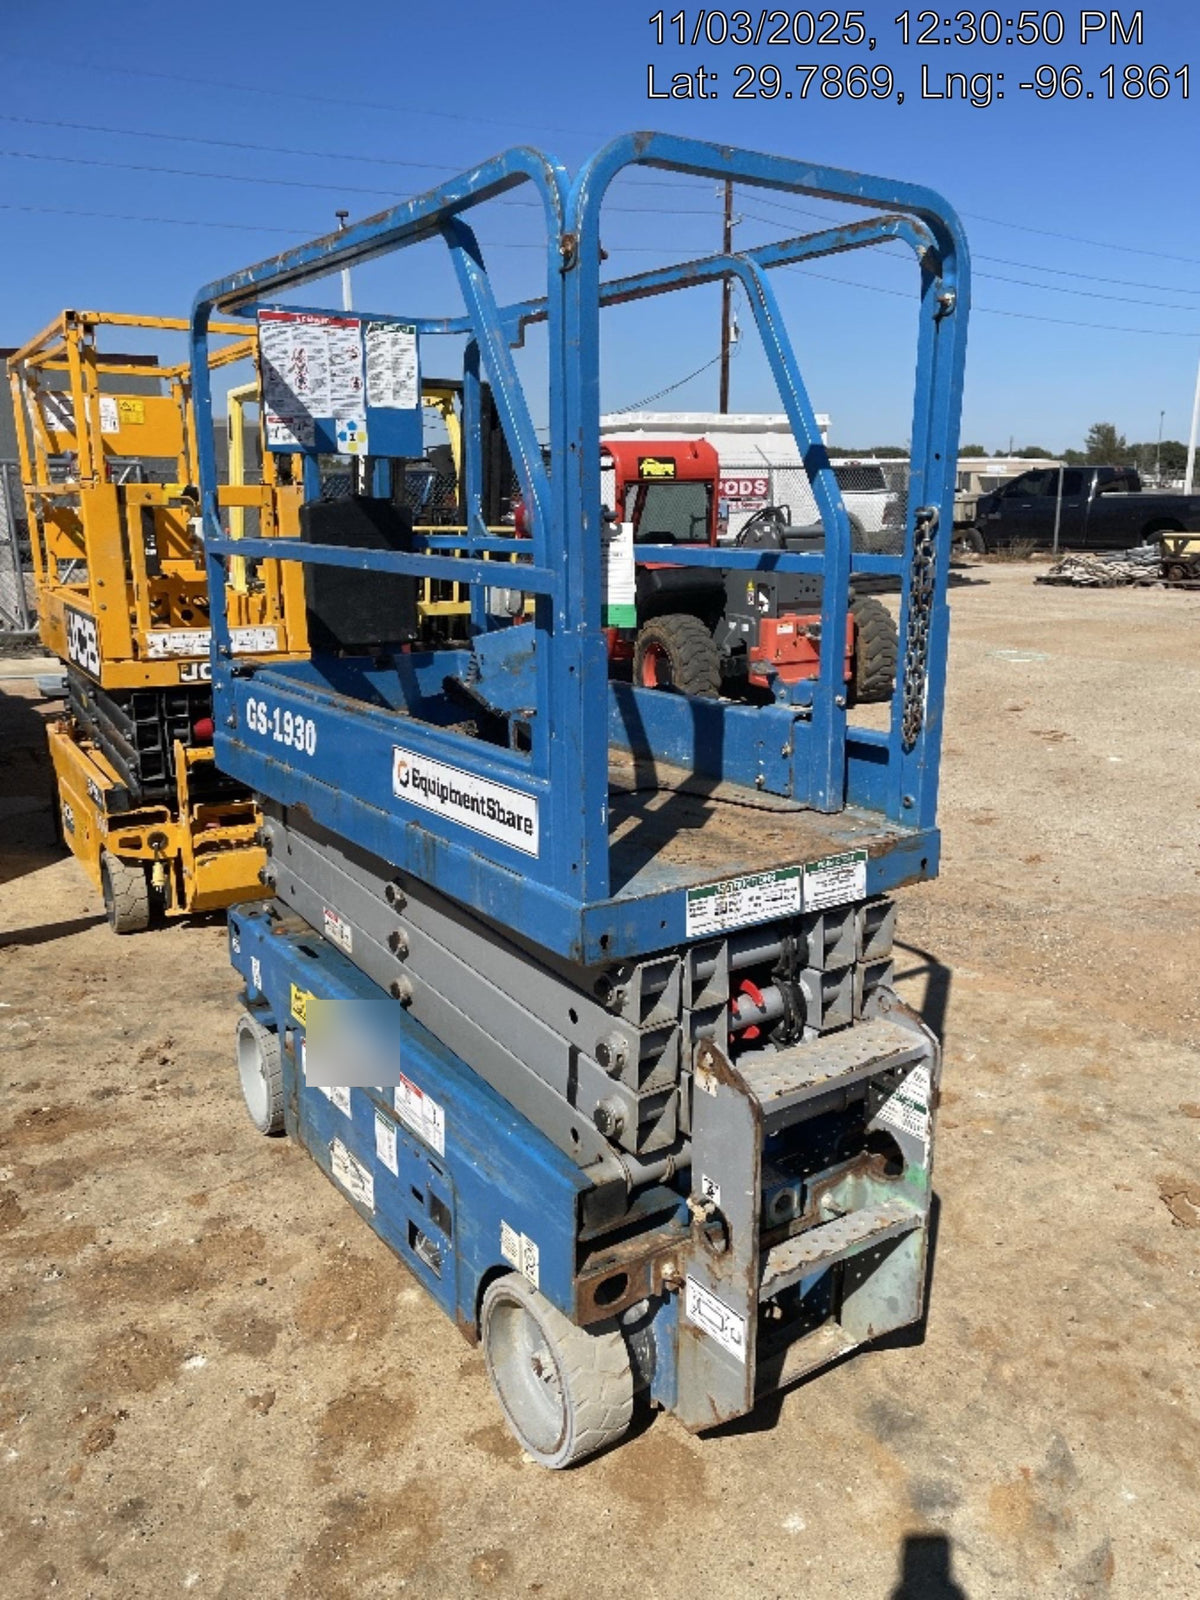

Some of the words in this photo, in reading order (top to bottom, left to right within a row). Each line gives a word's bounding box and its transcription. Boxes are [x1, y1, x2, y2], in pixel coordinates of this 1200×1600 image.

[67, 610, 100, 677] JCB
[180, 662, 213, 682] JC
[246, 697, 317, 757] GS-1930
[411, 766, 534, 837] EquipmentShare
